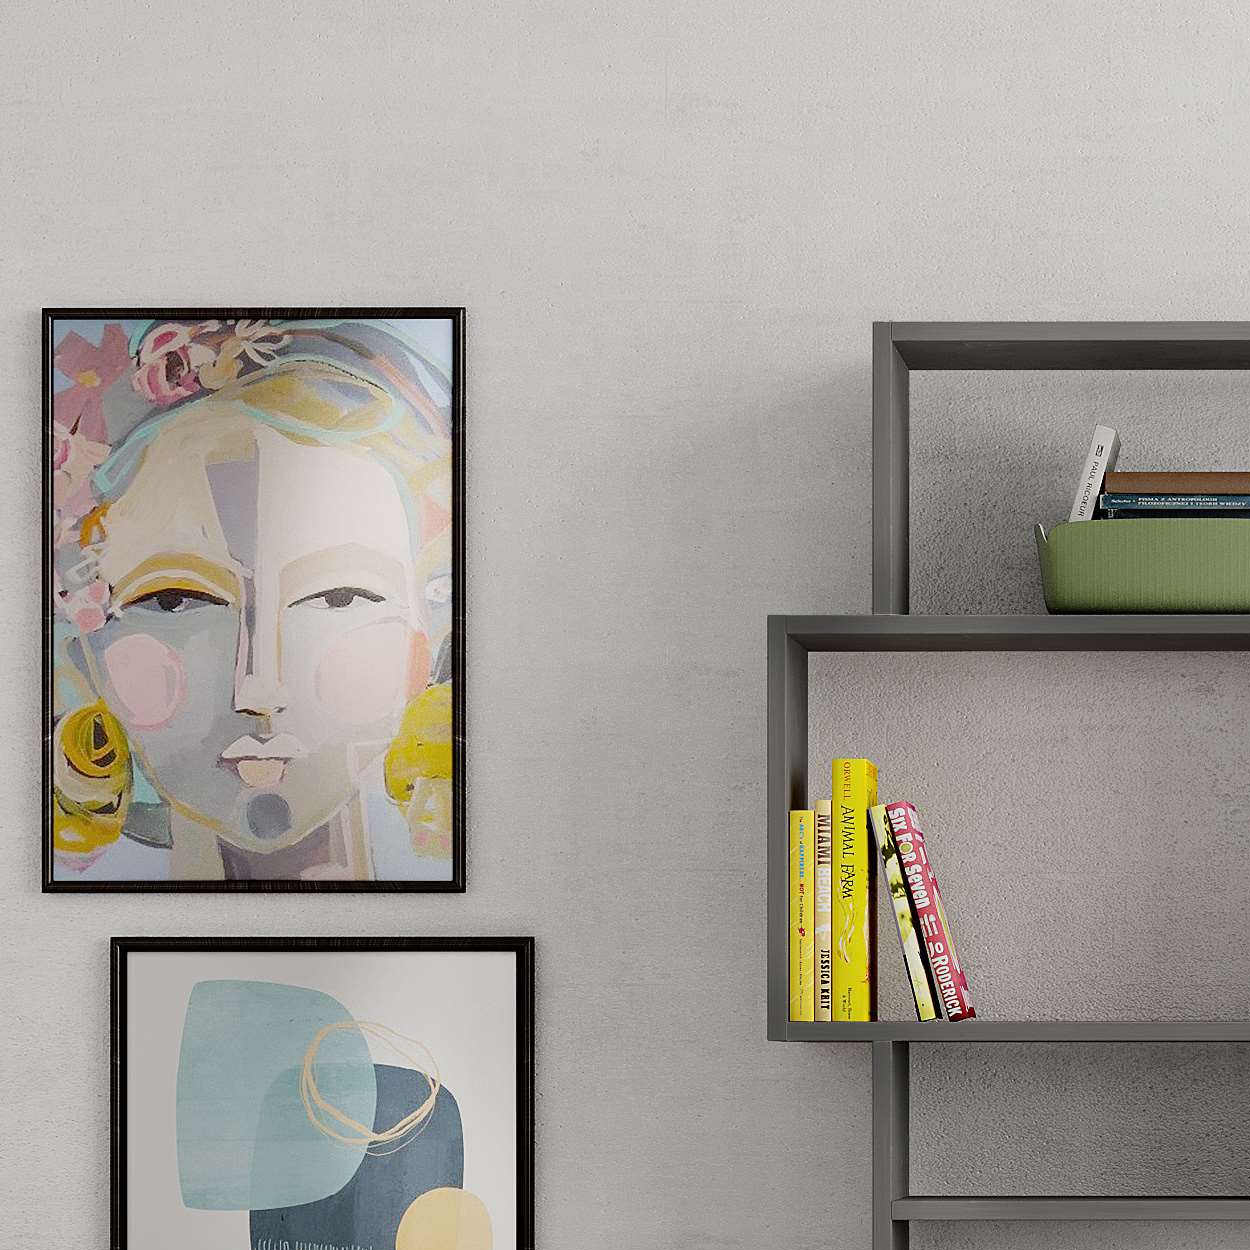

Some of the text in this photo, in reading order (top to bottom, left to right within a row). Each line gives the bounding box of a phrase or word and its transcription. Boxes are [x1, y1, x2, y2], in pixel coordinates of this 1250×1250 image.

[1078, 461, 1099, 517] PAUL RICOEUR
[843, 762, 851, 800] ORWELL
[817, 814, 831, 912] MIAMI BEACH
[840, 805, 856, 899] ANIMAL FARM
[888, 807, 907, 832] SIX
[905, 862, 930, 909] Seven
[820, 949, 830, 985] JESSICA
[933, 955, 963, 1017] RODERICK
